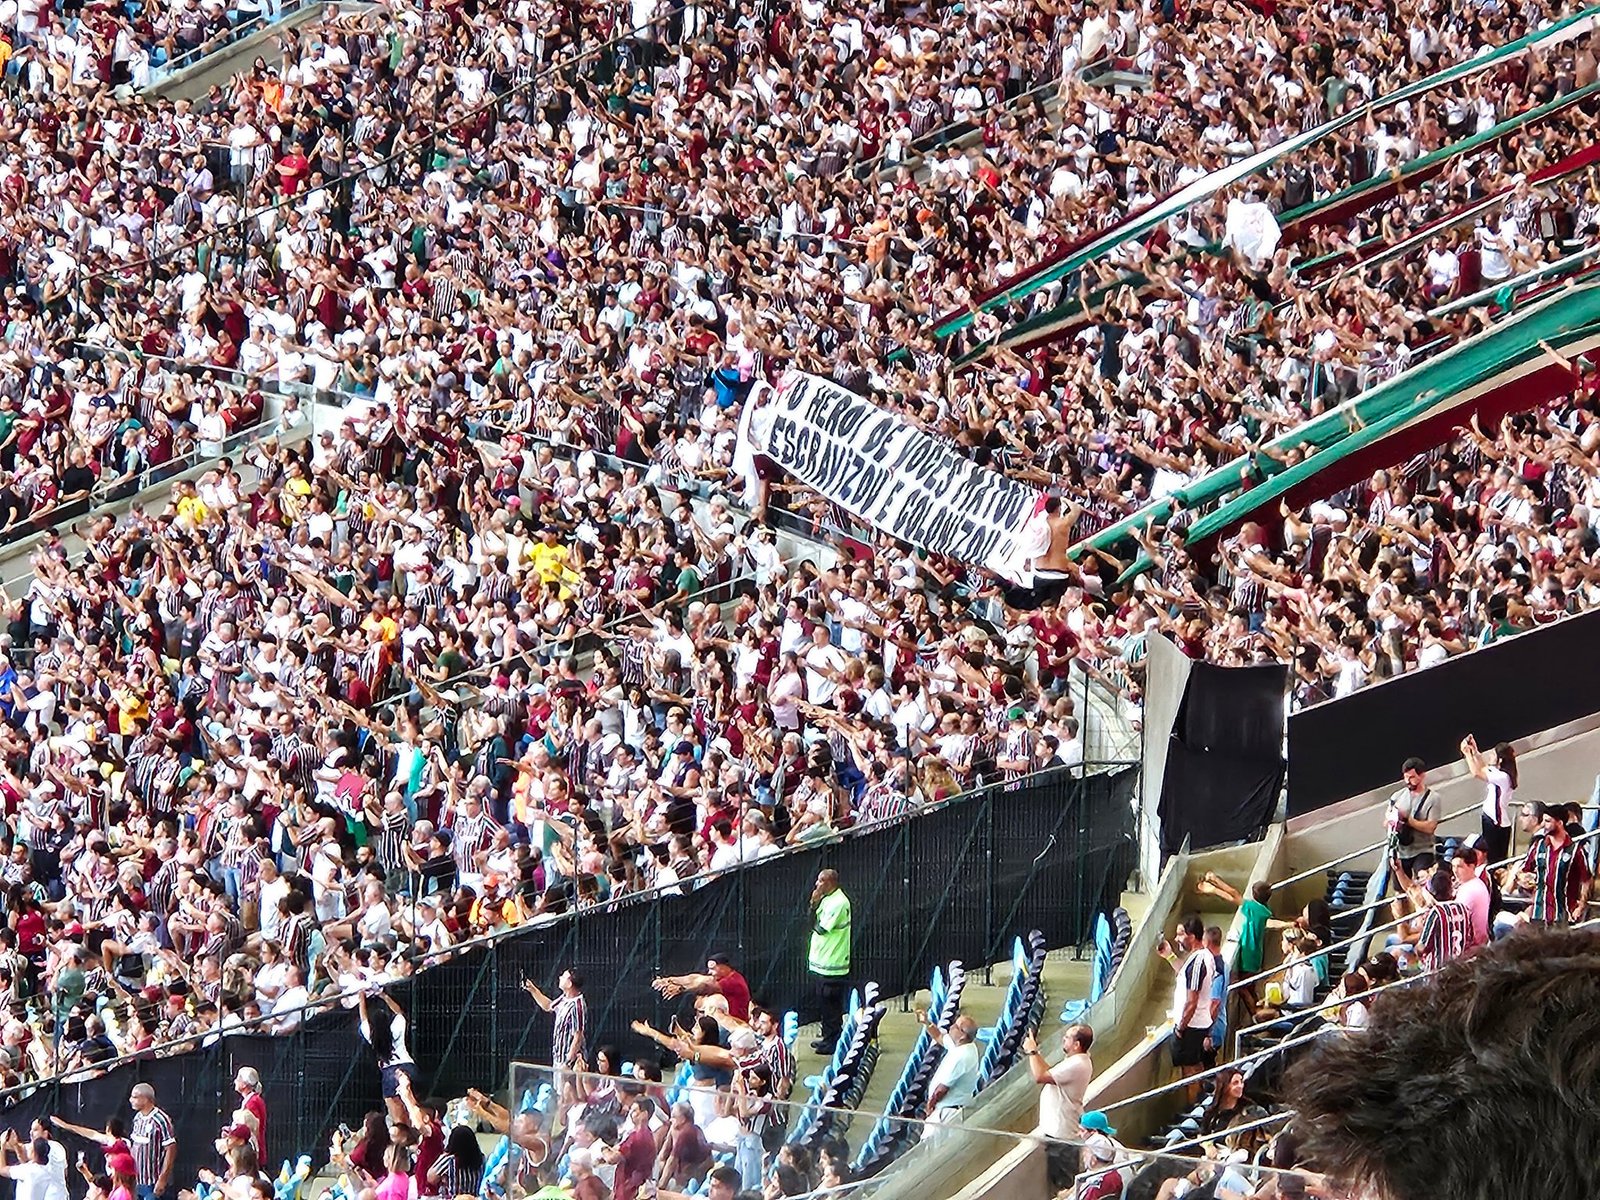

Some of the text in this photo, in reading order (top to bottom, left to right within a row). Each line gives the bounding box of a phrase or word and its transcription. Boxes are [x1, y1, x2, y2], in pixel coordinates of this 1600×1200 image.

[768, 414, 889, 515] ESCRAVIZOU
[874, 479, 905, 521] E
[787, 377, 810, 411] O
[861, 416, 907, 463] DE
